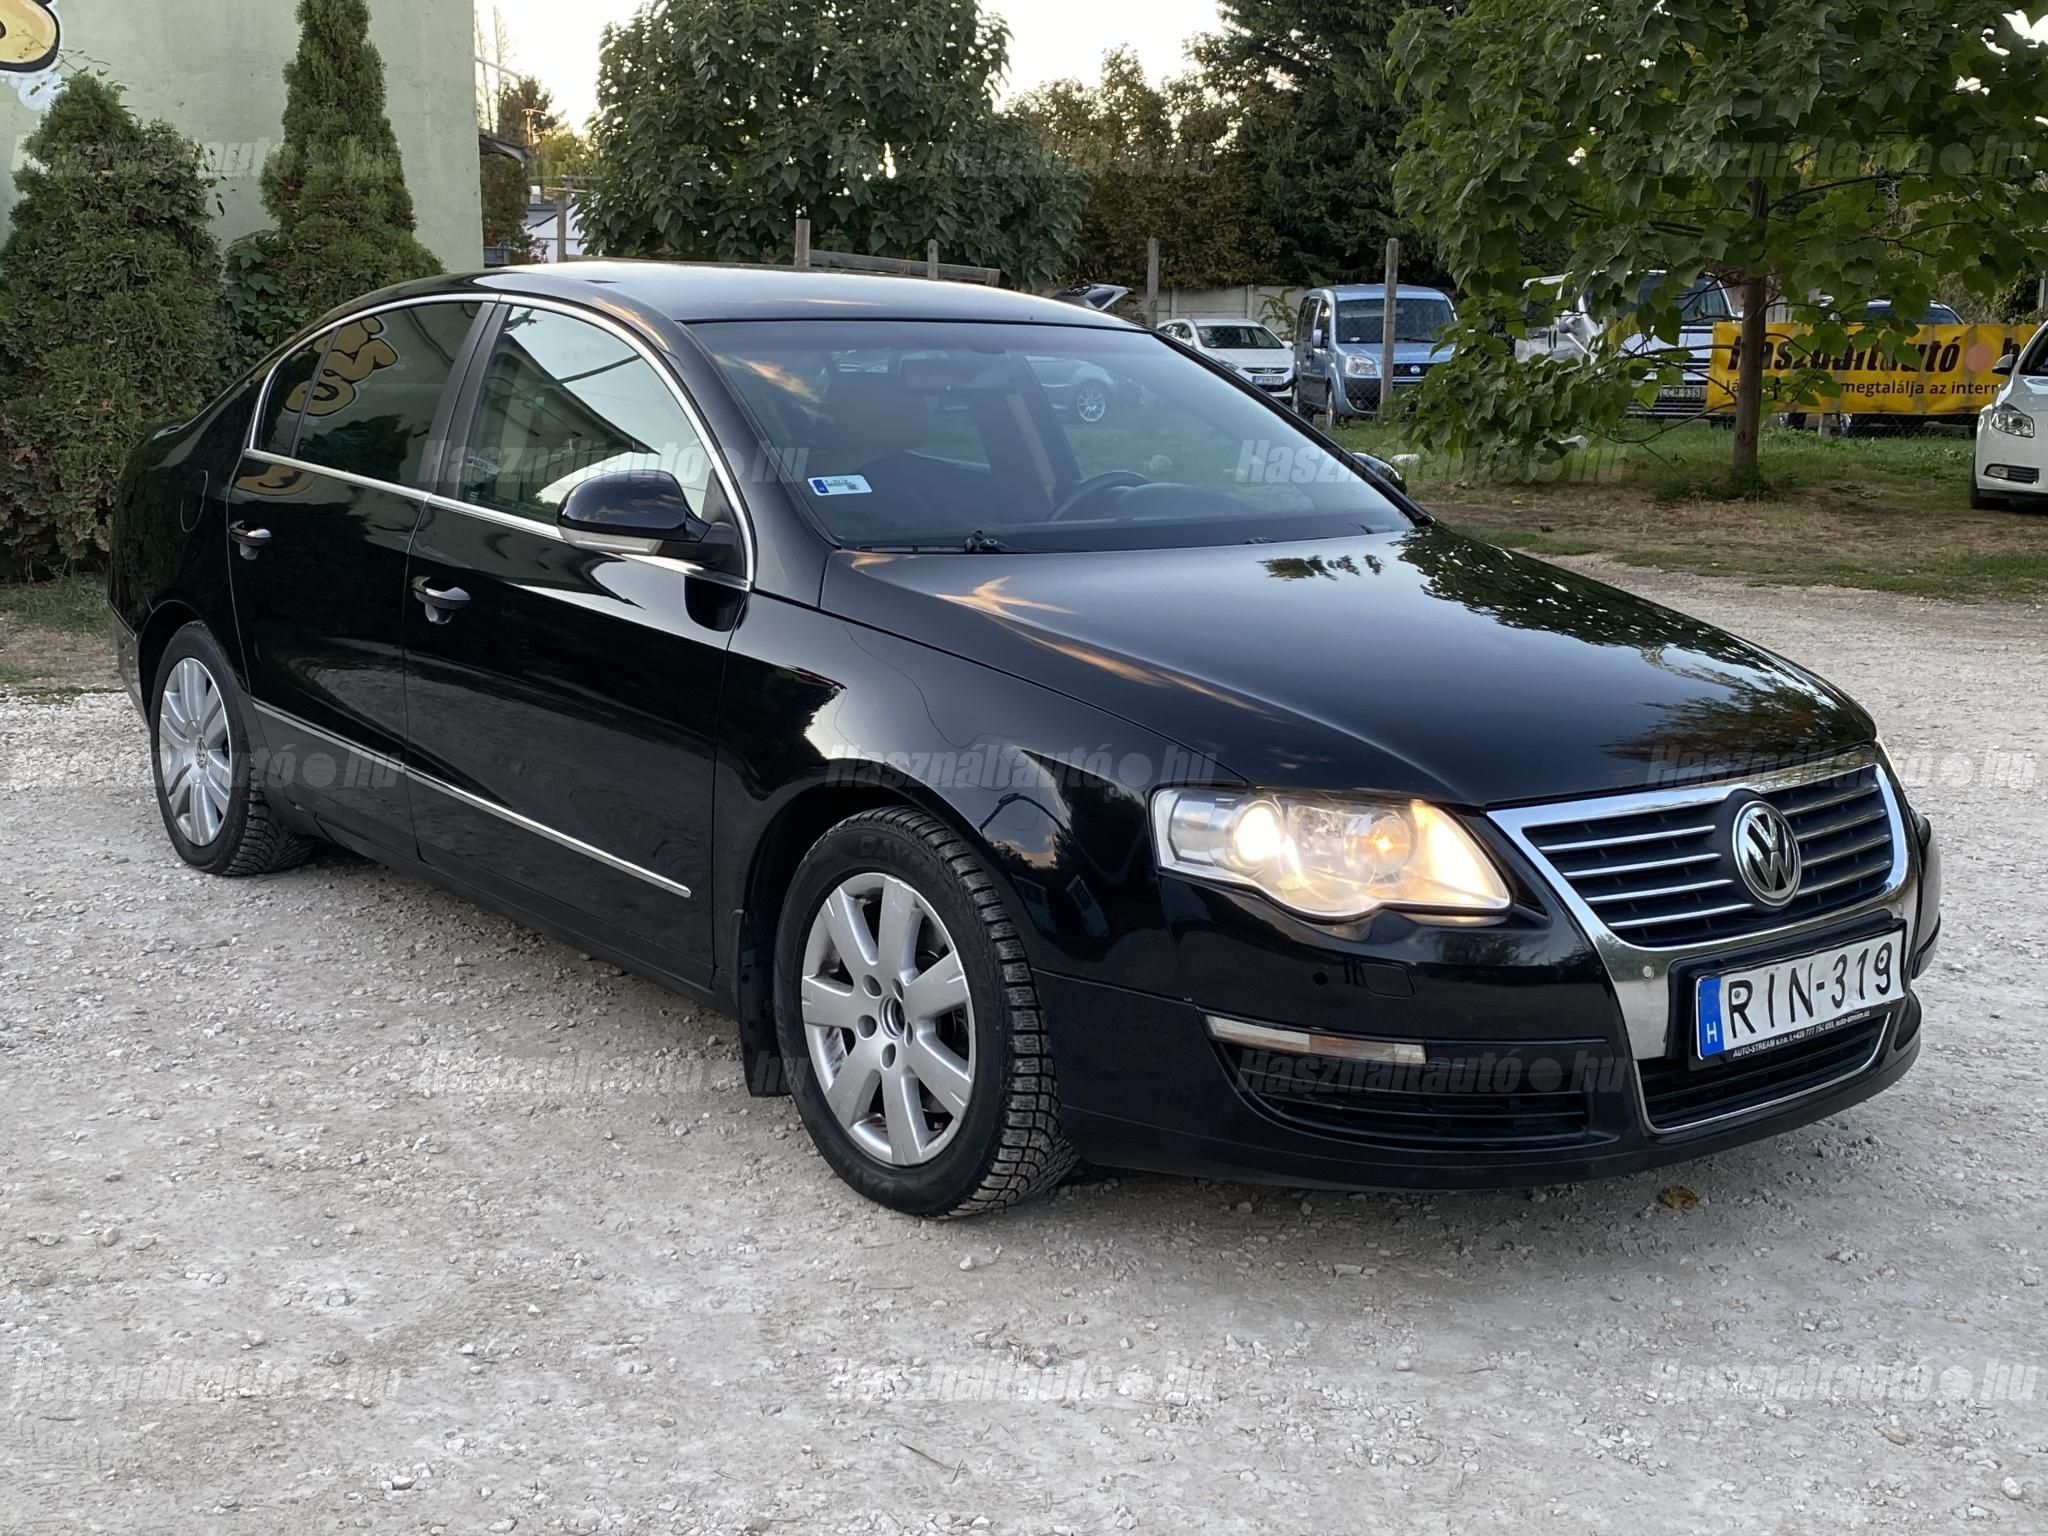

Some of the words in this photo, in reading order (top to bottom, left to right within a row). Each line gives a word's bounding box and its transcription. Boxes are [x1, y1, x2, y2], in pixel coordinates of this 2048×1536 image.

[1930, 385, 1946, 395] az
[1728, 942, 1893, 1039] RIN-319
[1706, 1021, 1719, 1044] H
